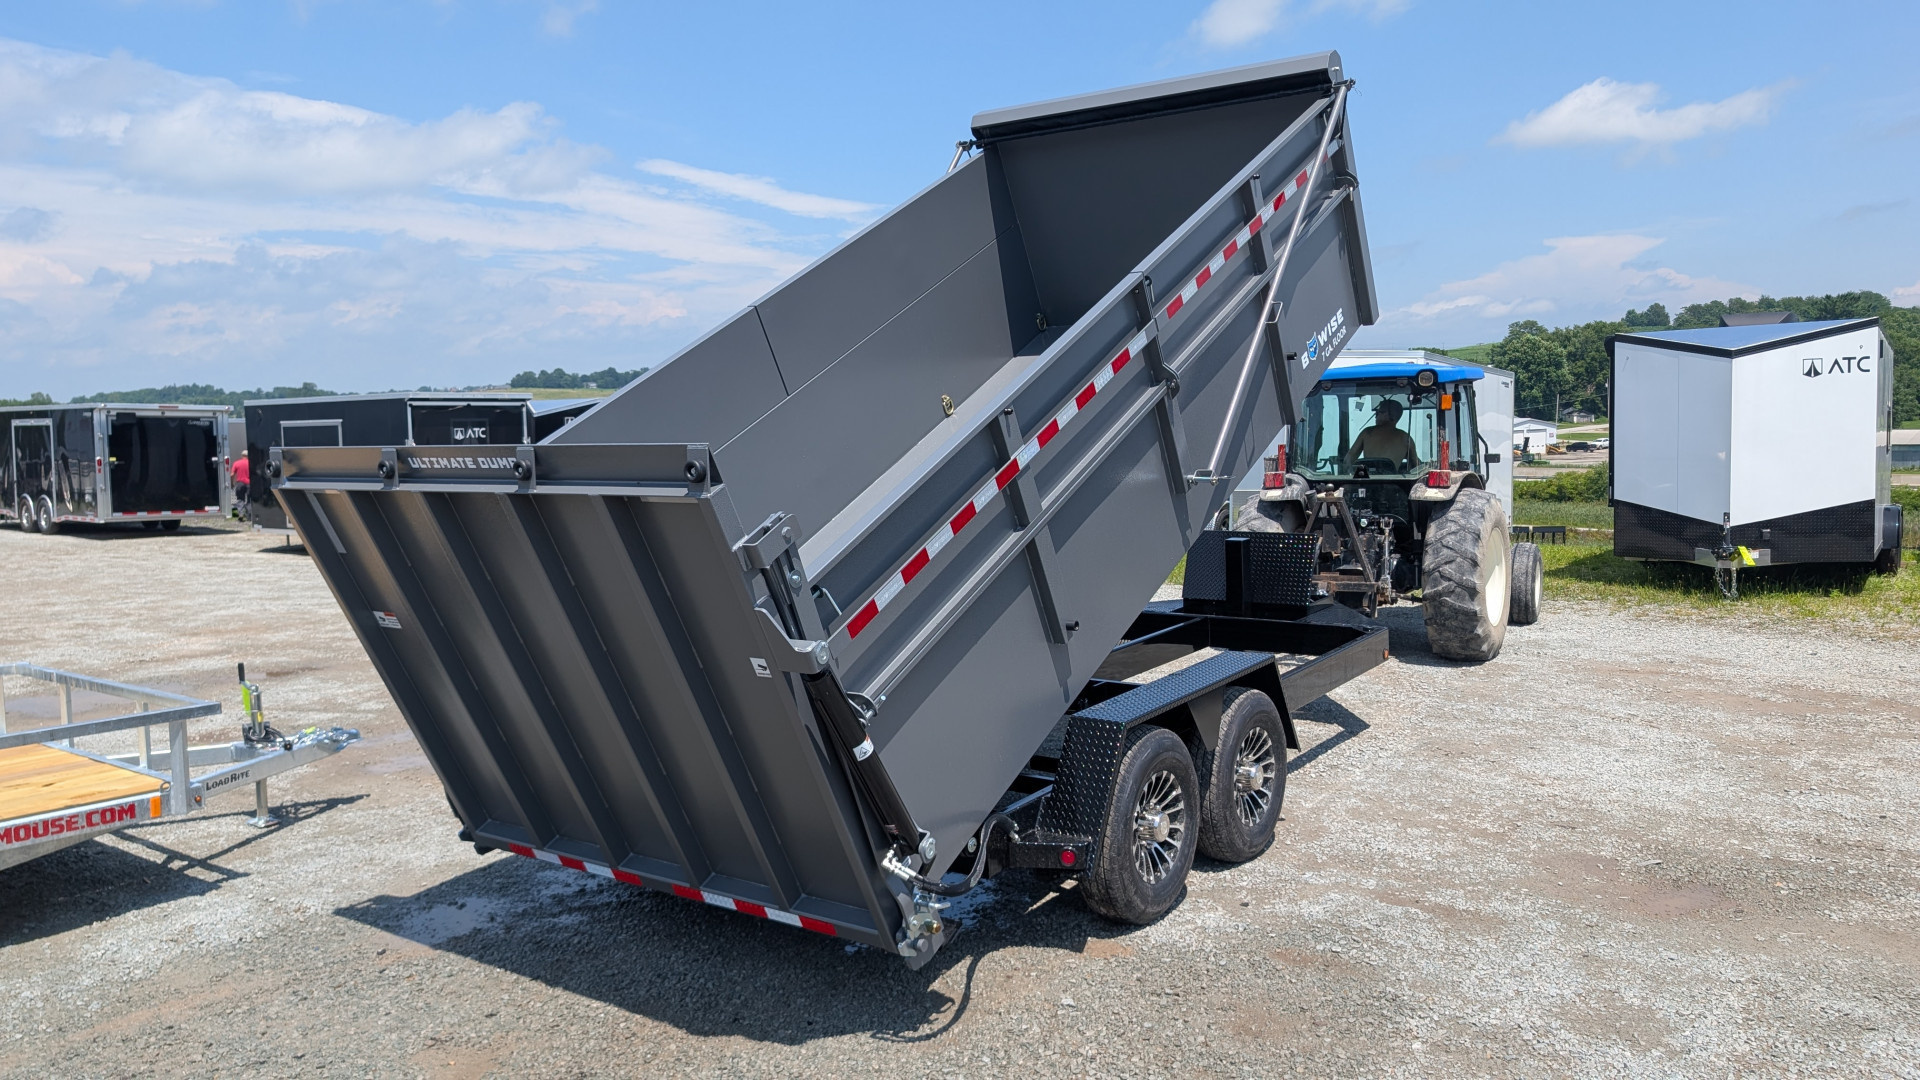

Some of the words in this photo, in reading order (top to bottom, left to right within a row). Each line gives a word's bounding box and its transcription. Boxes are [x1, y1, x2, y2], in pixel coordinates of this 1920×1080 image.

[1828, 355, 1871, 375] ATC
[466, 427, 487, 439] ATC
[407, 457, 477, 469] ULTIMATE
